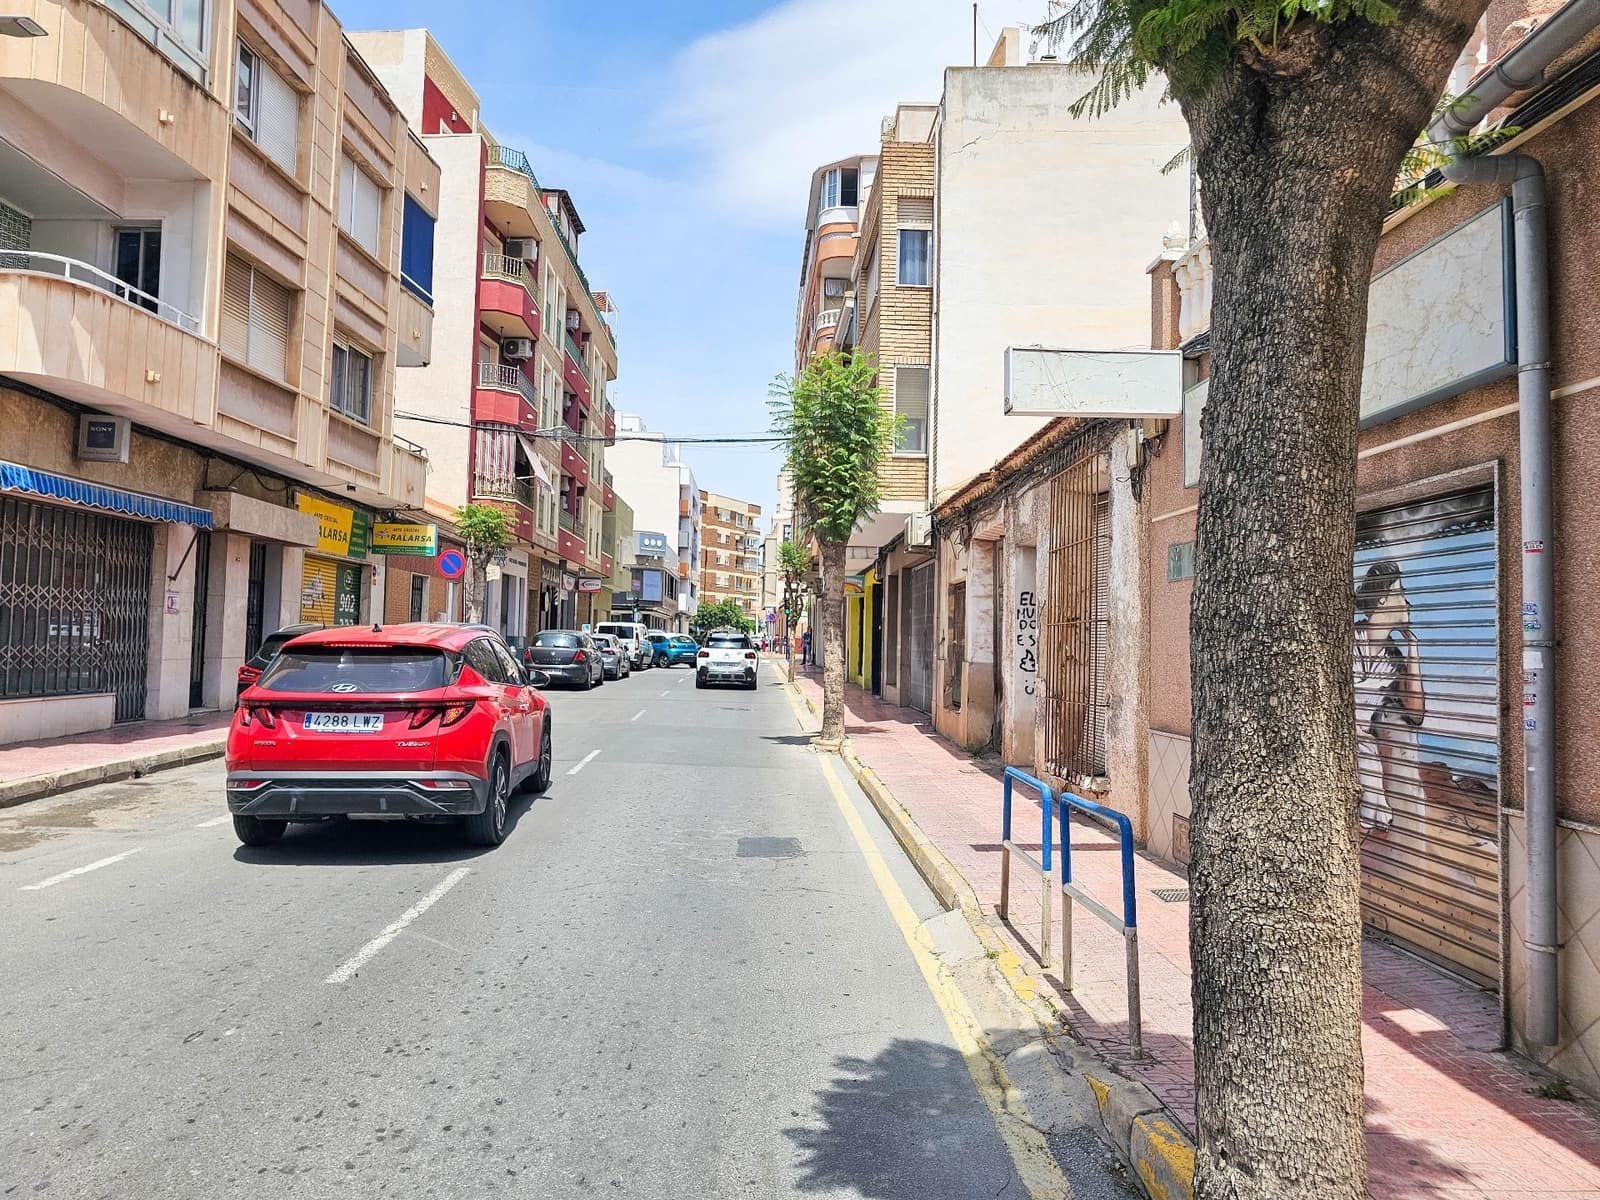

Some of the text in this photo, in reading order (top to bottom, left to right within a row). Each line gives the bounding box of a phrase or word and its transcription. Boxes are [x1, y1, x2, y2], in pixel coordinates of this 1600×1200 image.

[318, 526, 347, 543] ALARSA
[390, 534, 432, 542] RALARSA
[339, 594, 355, 612] 902
[1020, 592, 1036, 606] EL
[314, 715, 380, 728] 4288 LWZ
